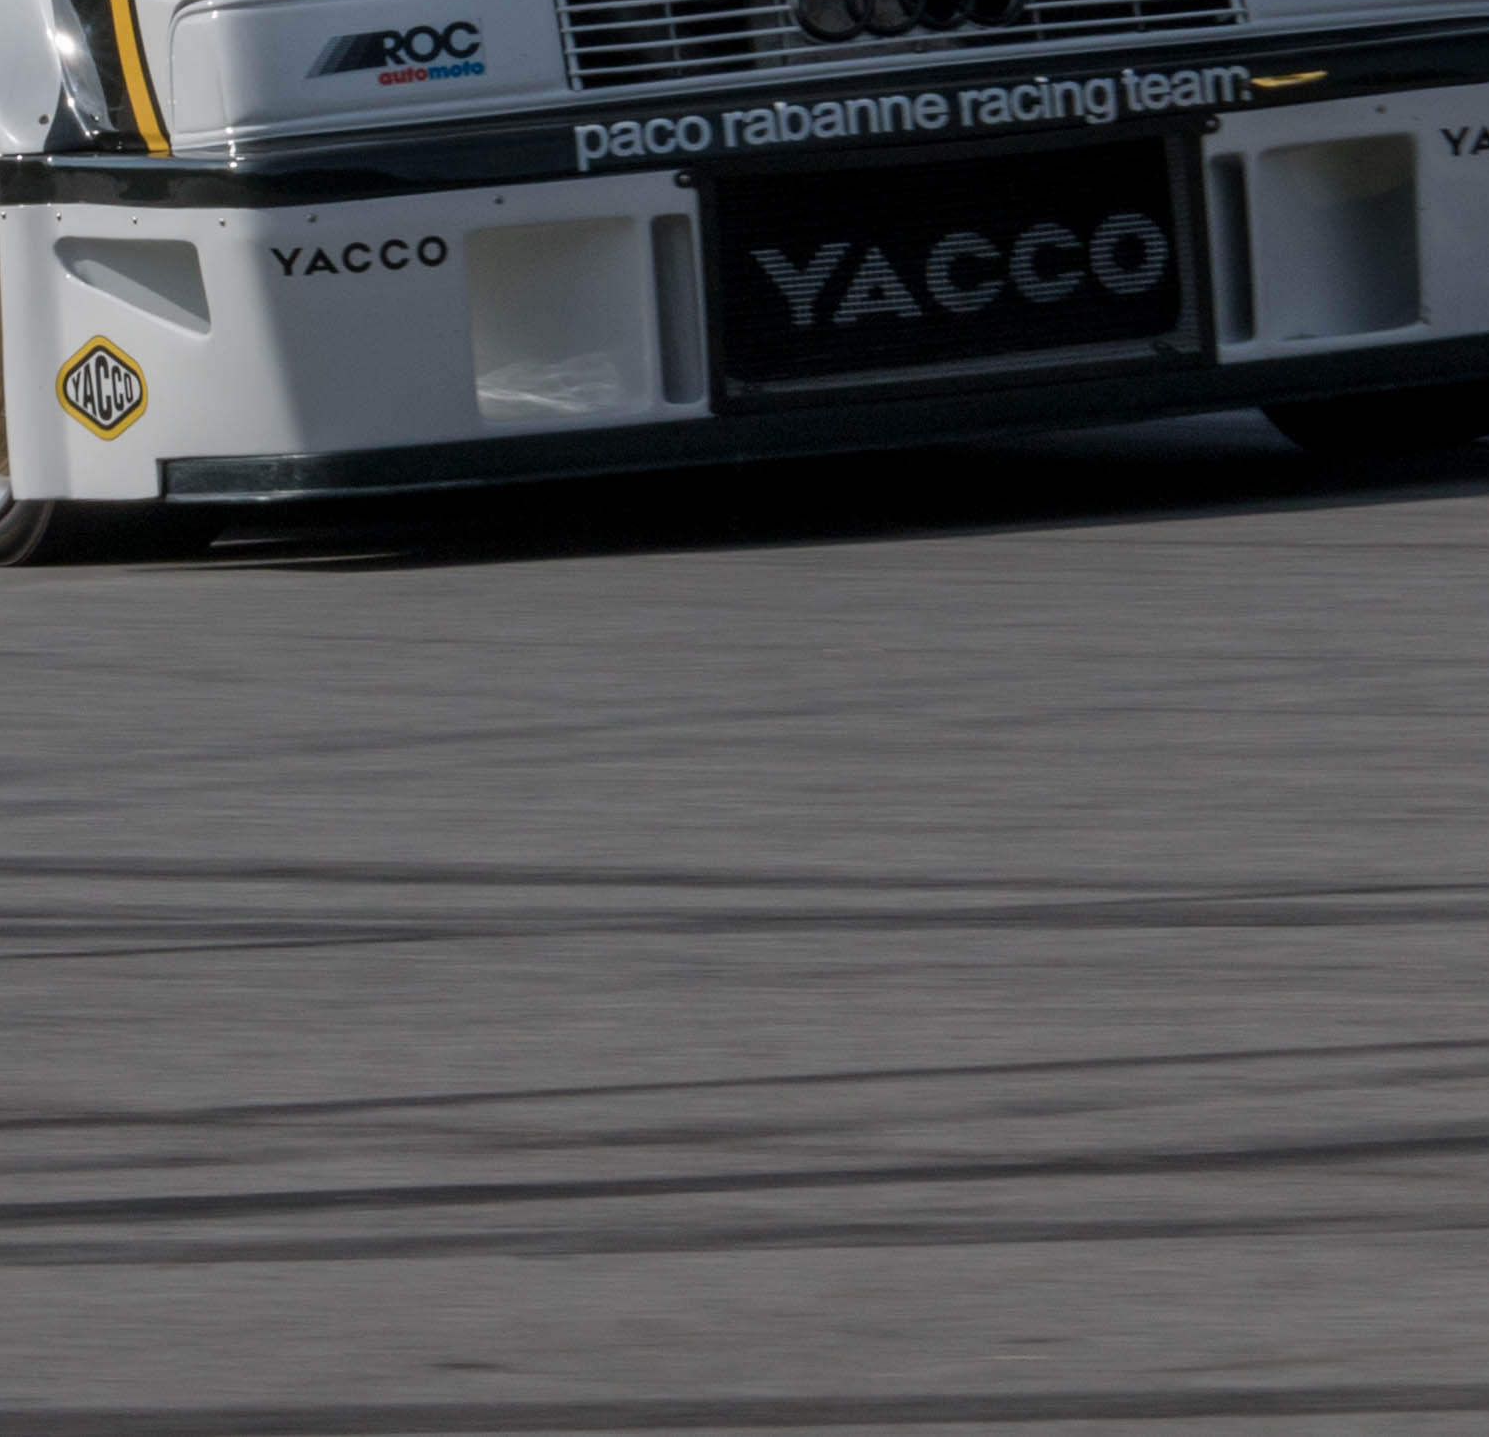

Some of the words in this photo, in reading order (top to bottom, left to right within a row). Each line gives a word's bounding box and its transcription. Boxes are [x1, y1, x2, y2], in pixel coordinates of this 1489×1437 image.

[379, 20, 481, 66] ROC
[378, 61, 485, 86] automoto
[574, 114, 710, 171] paco
[721, 92, 949, 147] rabanne
[958, 75, 1118, 125] racing
[270, 235, 448, 277] YACCO
[750, 212, 1170, 326] YACCO
[72, 354, 134, 422] YACCO
